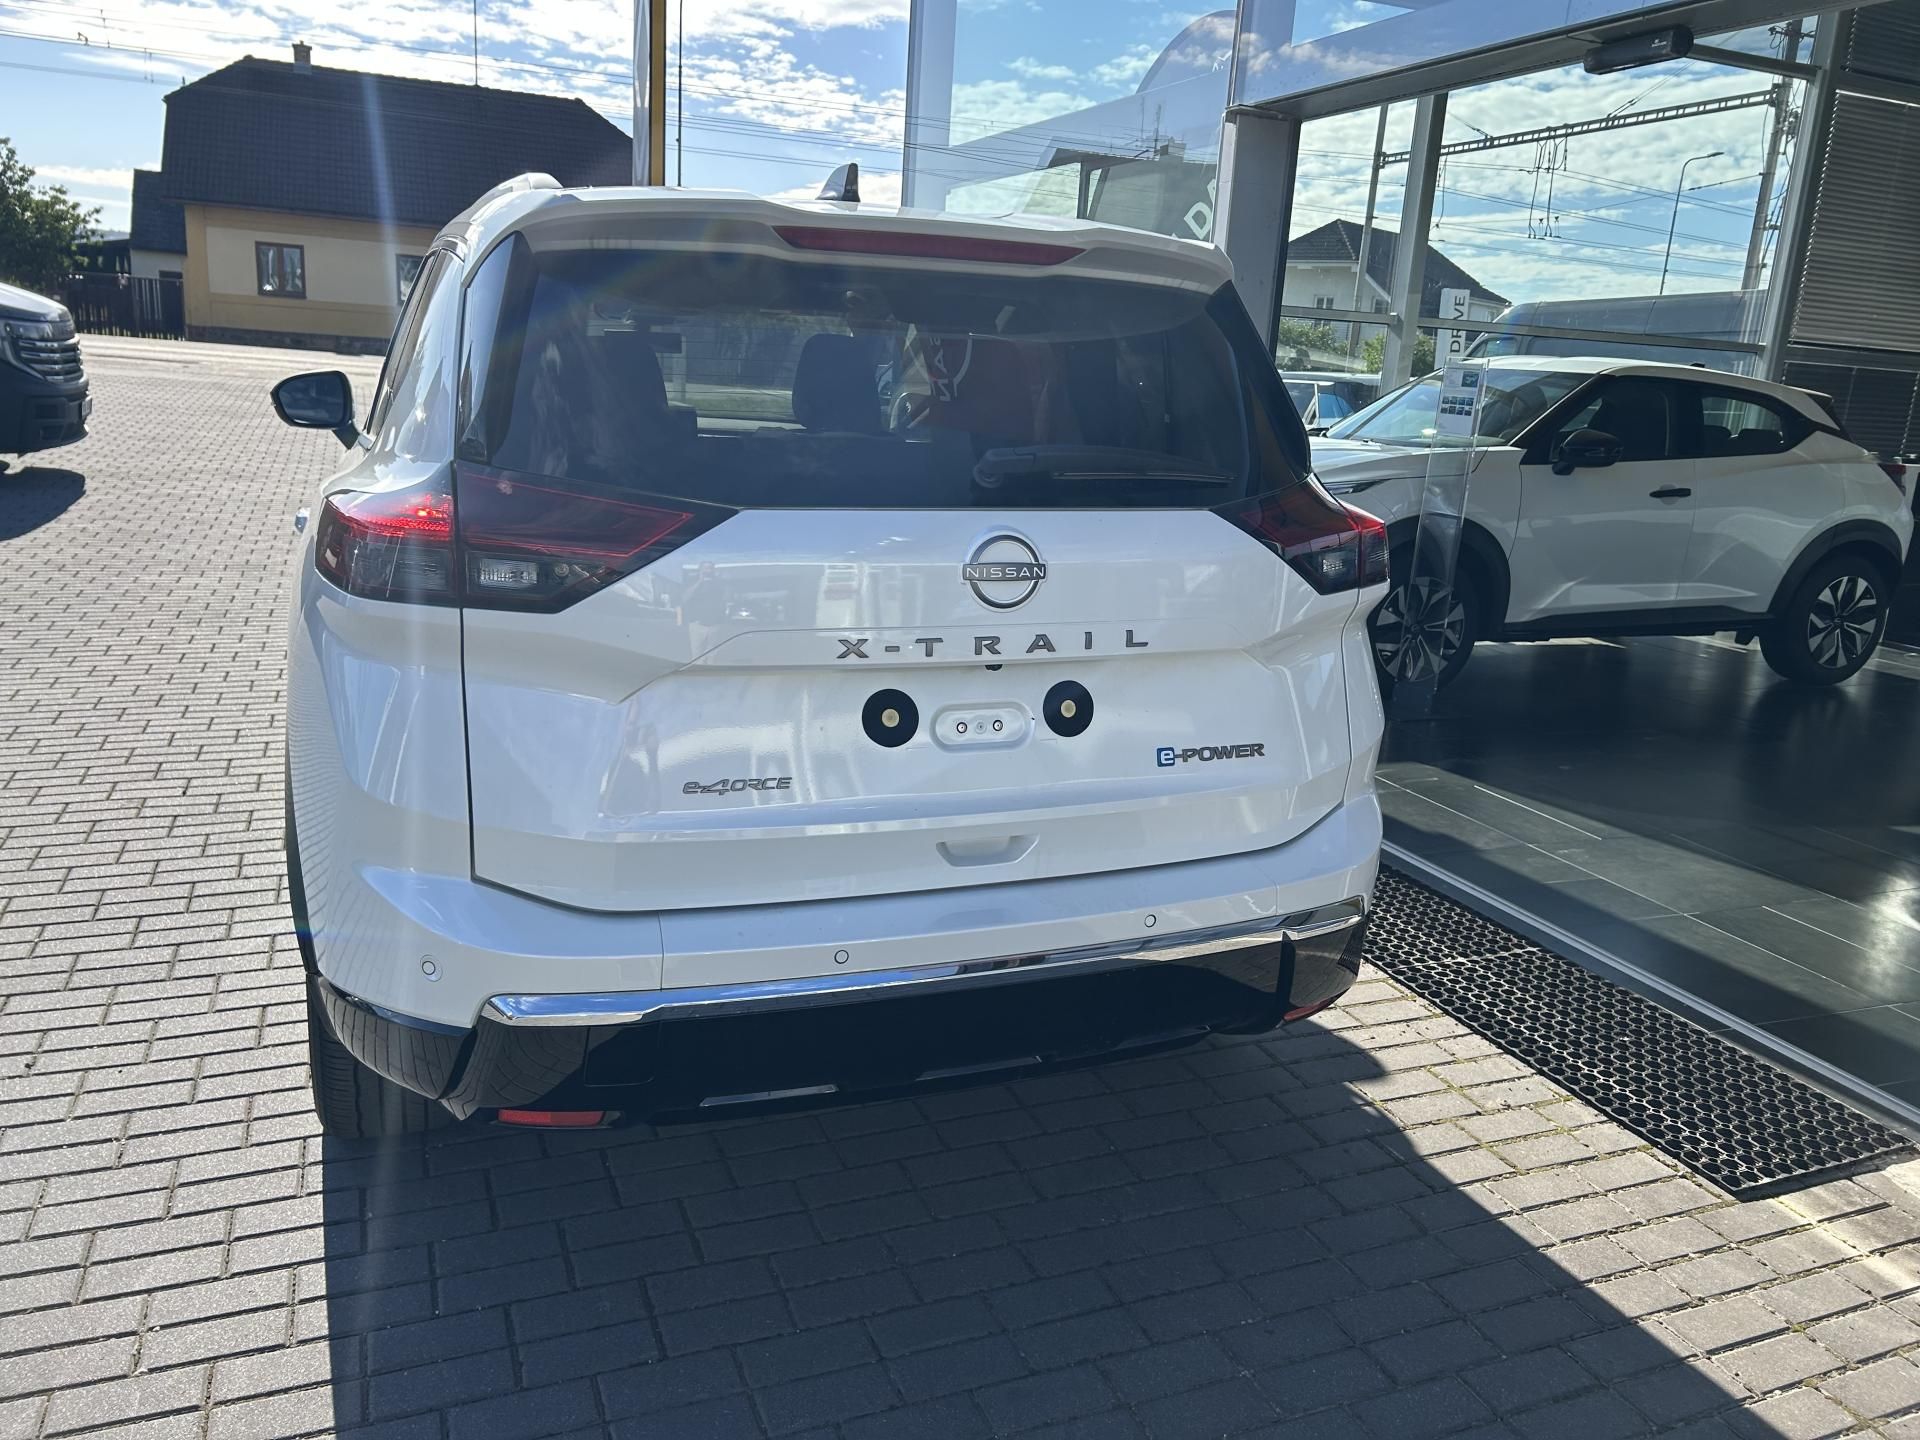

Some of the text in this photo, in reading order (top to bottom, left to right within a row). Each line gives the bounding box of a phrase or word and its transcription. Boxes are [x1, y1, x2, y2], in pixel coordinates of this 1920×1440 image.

[1450, 296, 1466, 353] DRVE
[966, 567, 1045, 578] NISSAN
[836, 629, 1149, 659] X-TRAIL
